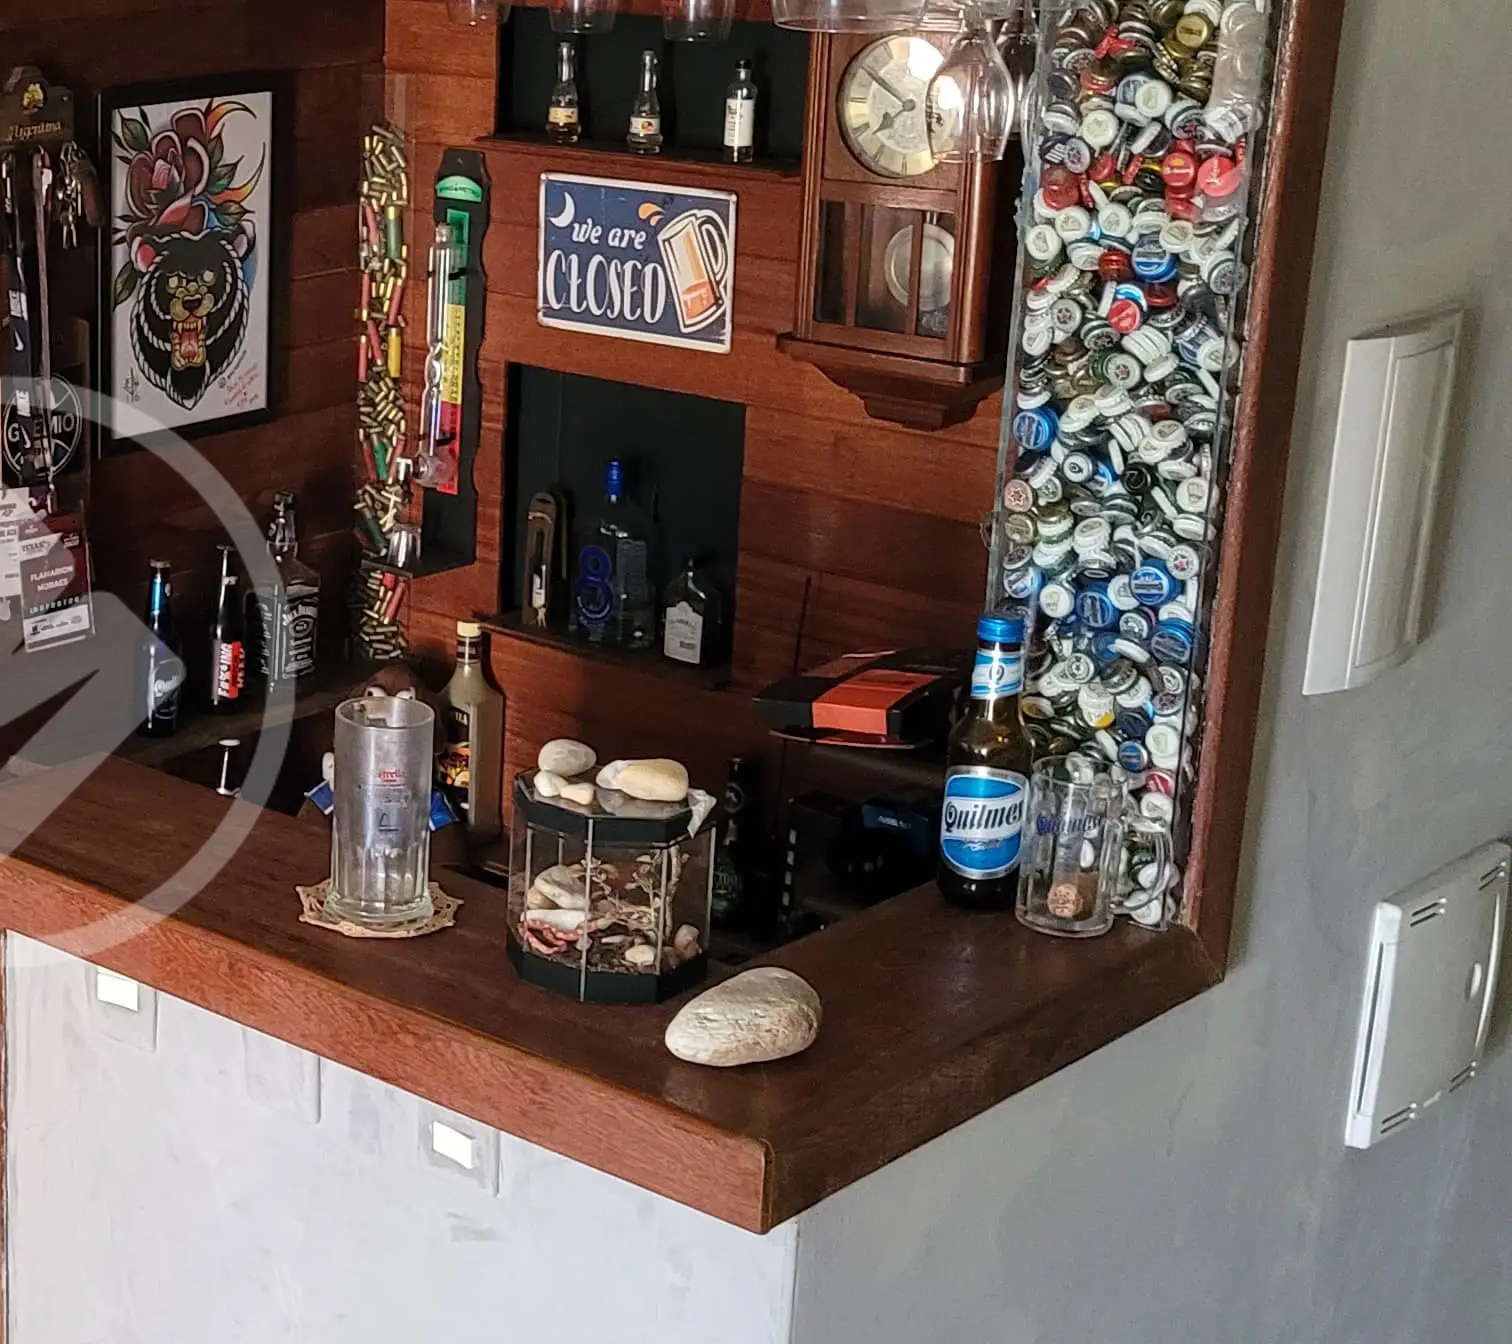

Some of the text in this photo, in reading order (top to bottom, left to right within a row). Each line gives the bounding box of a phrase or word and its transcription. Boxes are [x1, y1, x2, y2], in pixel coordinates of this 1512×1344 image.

[608, 227, 646, 249] are
[546, 250, 666, 324] CLOSED
[944, 800, 1024, 833] Quilmes
